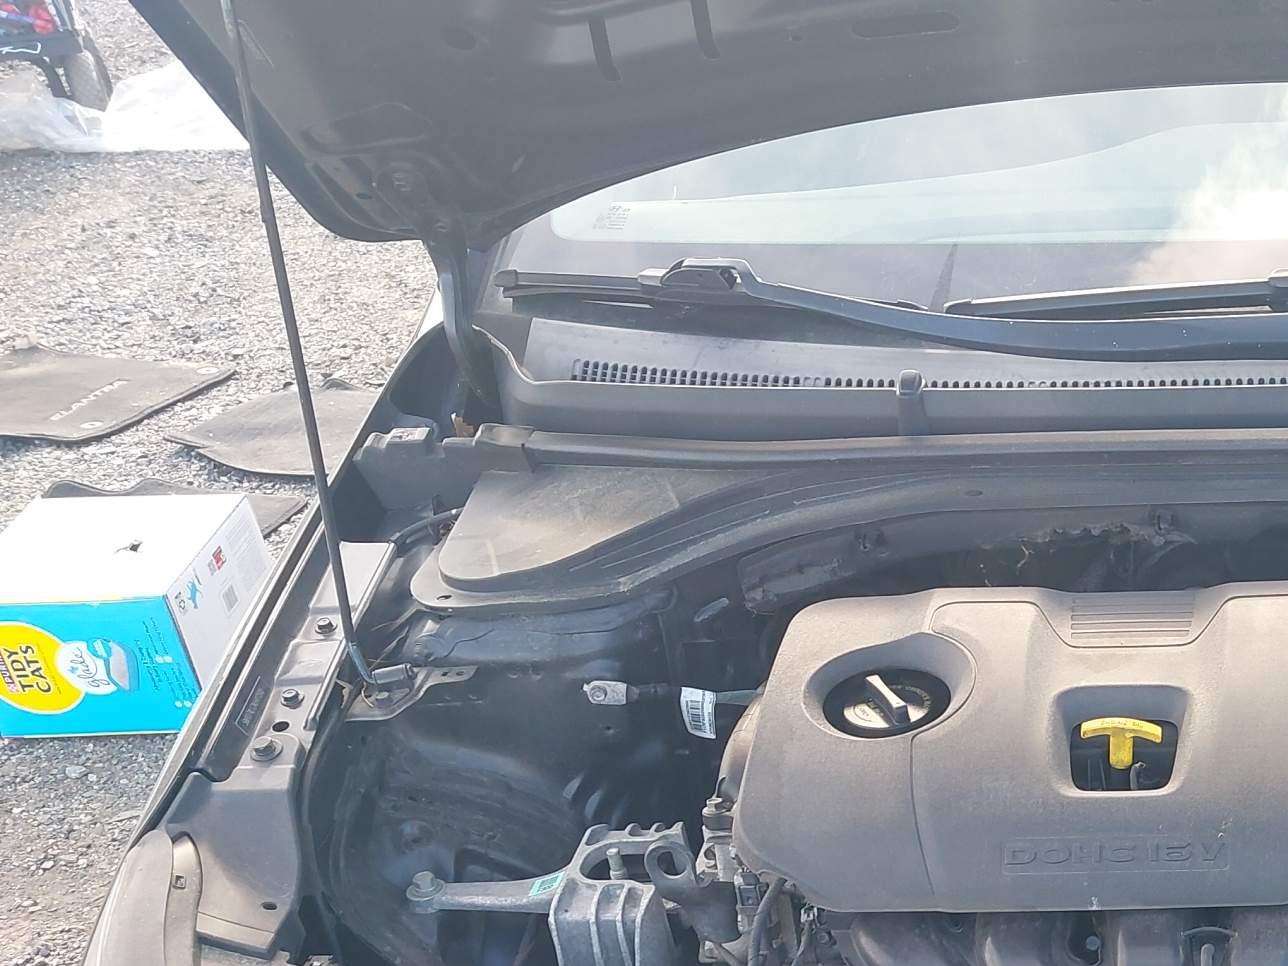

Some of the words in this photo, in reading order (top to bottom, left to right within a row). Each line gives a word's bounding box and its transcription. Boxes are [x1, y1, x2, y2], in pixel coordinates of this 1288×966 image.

[3, 648, 34, 692] TIDY
[19, 645, 52, 693] CATS
[70, 646, 111, 688] glade
